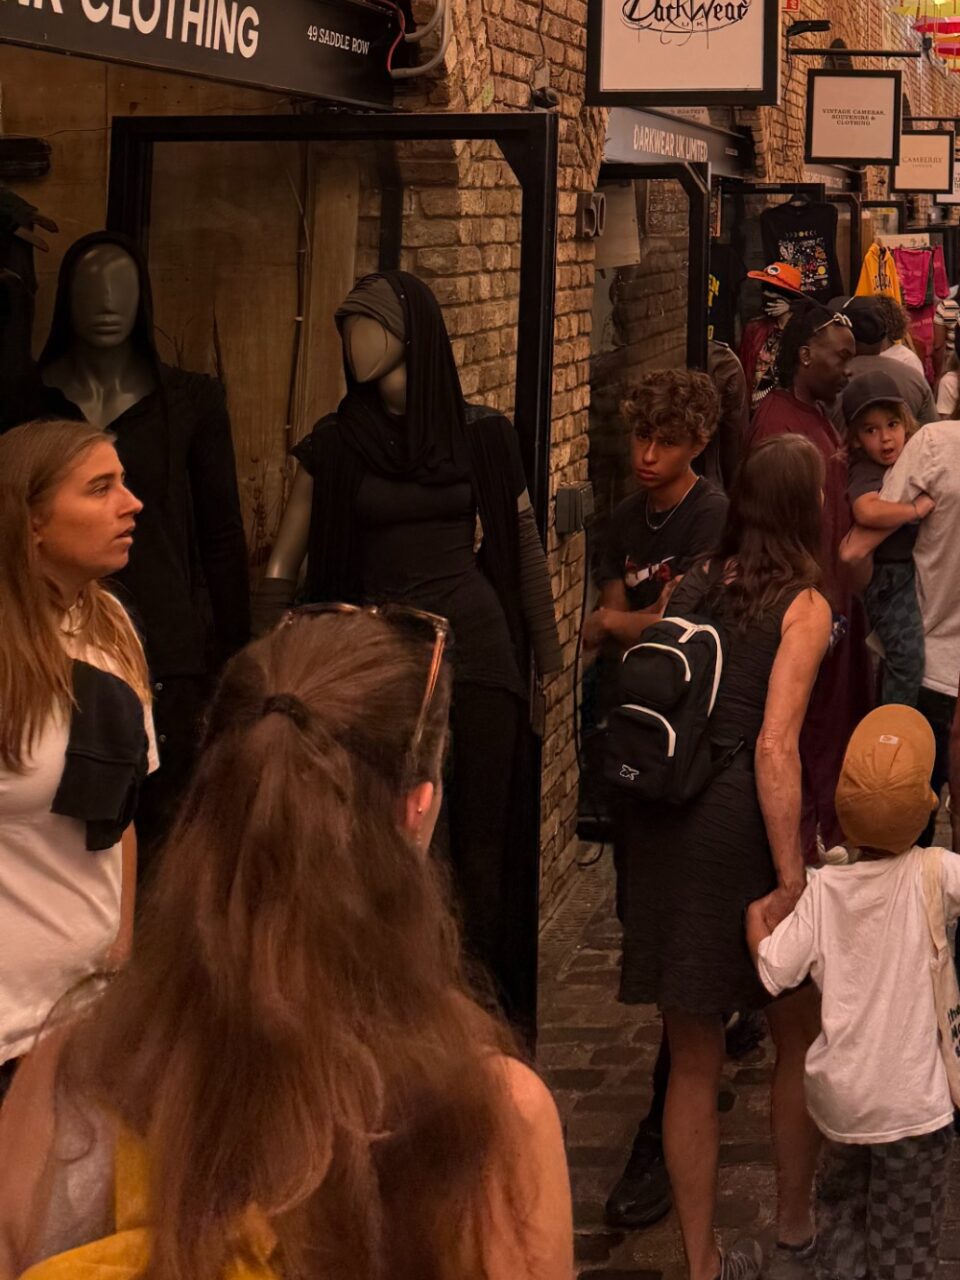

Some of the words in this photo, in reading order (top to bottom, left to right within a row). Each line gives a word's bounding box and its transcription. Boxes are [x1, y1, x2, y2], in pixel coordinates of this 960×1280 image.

[307, 24, 318, 41] 49
[318, 28, 350, 50] SADDLE
[351, 37, 370, 55] ROW
[633, 123, 675, 157] DARKWEAR
